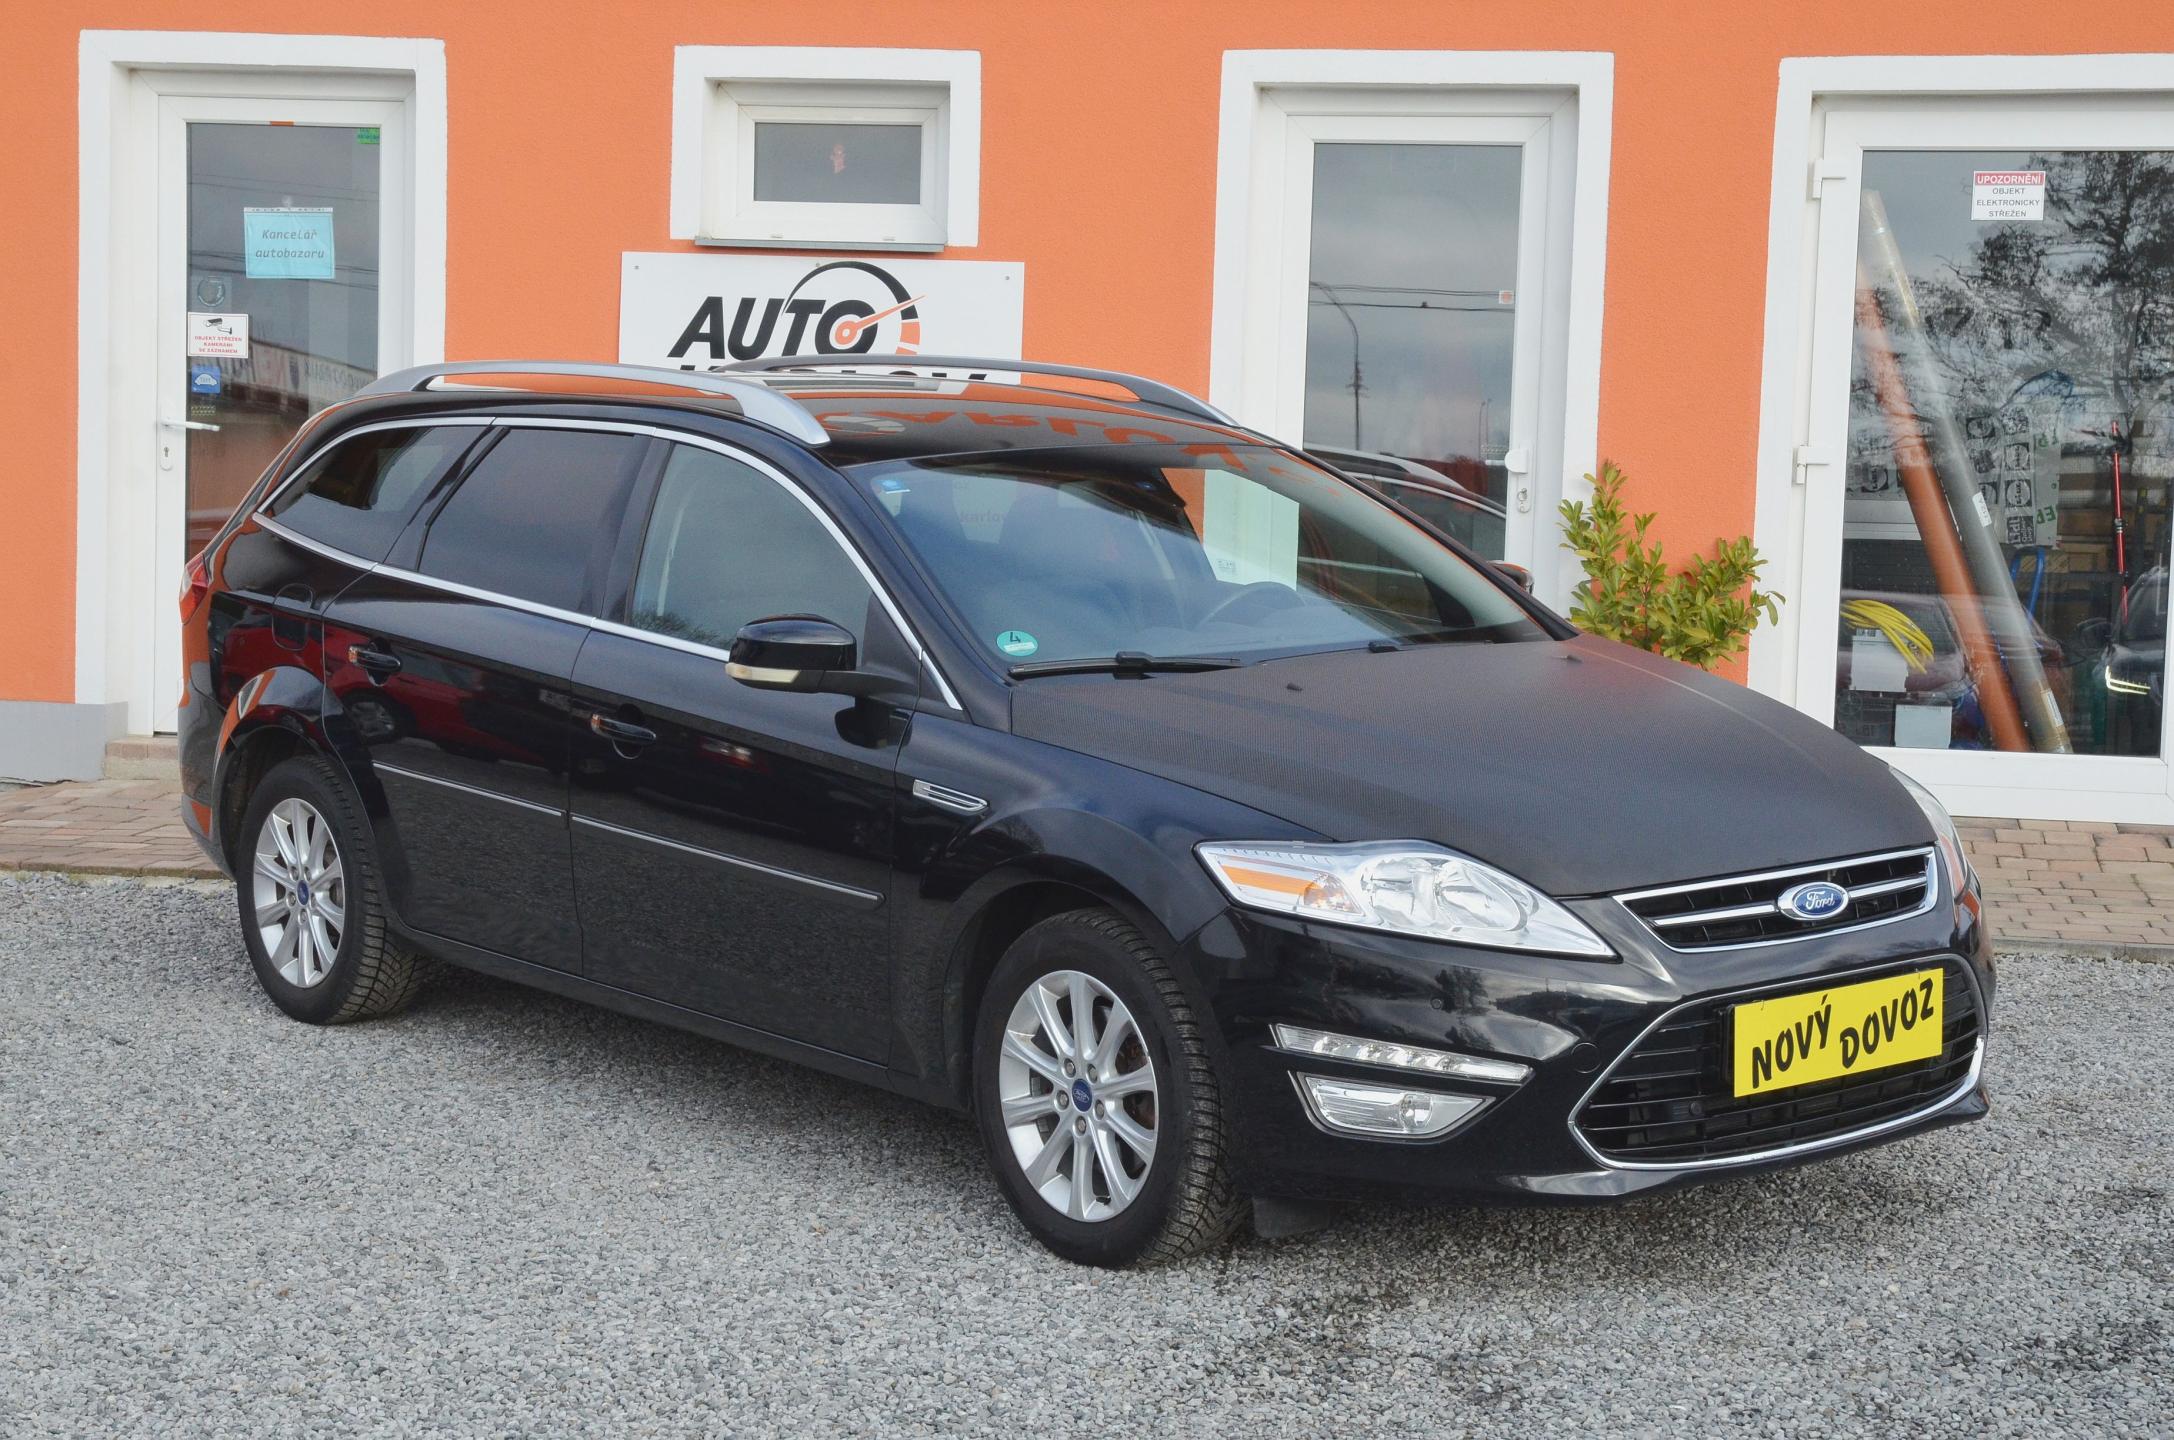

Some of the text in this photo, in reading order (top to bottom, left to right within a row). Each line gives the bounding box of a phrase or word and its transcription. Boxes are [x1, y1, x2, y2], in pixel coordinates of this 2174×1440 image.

[1977, 173, 2041, 184] UPOZORNĚNÍ
[1992, 187, 2025, 195] OBJEKT
[1988, 209, 2027, 217] STŘEŽEN
[261, 228, 319, 241] Kancelář
[254, 247, 326, 259] autobazaru
[666, 295, 879, 361] AUTO
[1805, 890, 1836, 910] Ford
[1752, 977, 1935, 1089] NOVÝ DOVOZ
